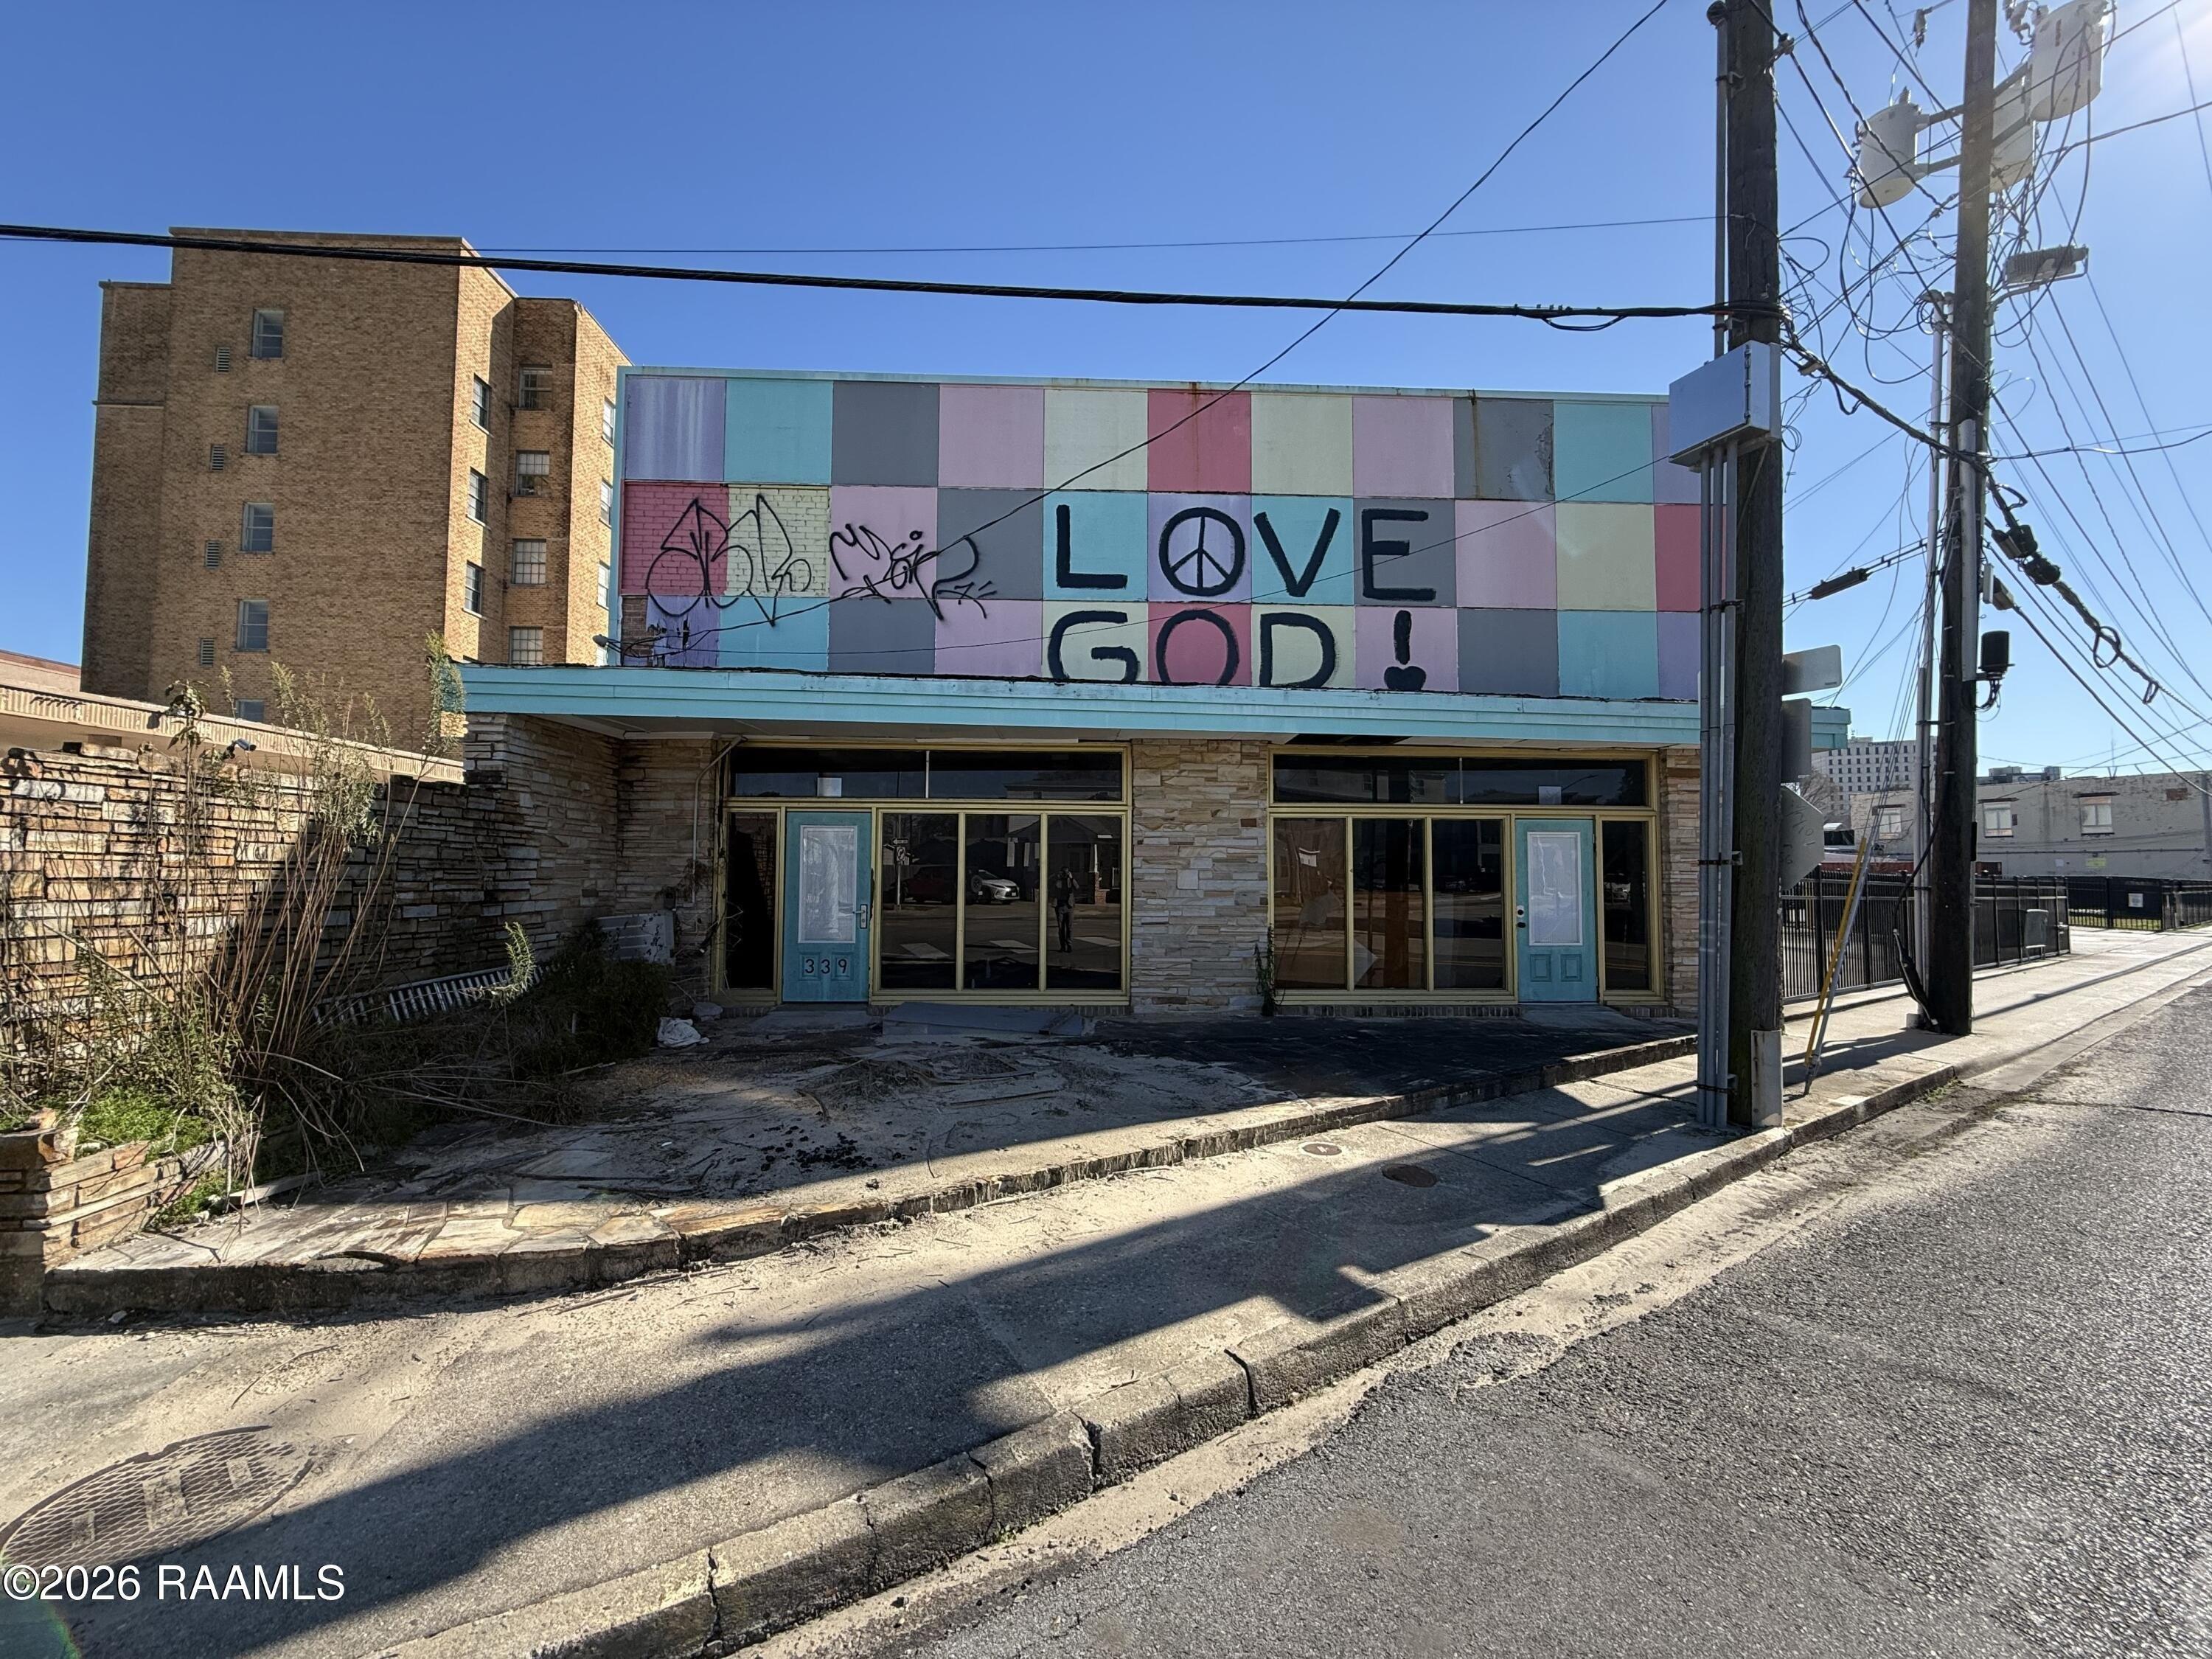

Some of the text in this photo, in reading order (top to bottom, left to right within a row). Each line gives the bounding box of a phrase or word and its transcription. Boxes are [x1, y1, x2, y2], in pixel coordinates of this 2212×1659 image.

[1056, 504, 1436, 601] LOVE
[1047, 609, 1427, 691] GOD!
[804, 959, 848, 974] 339
